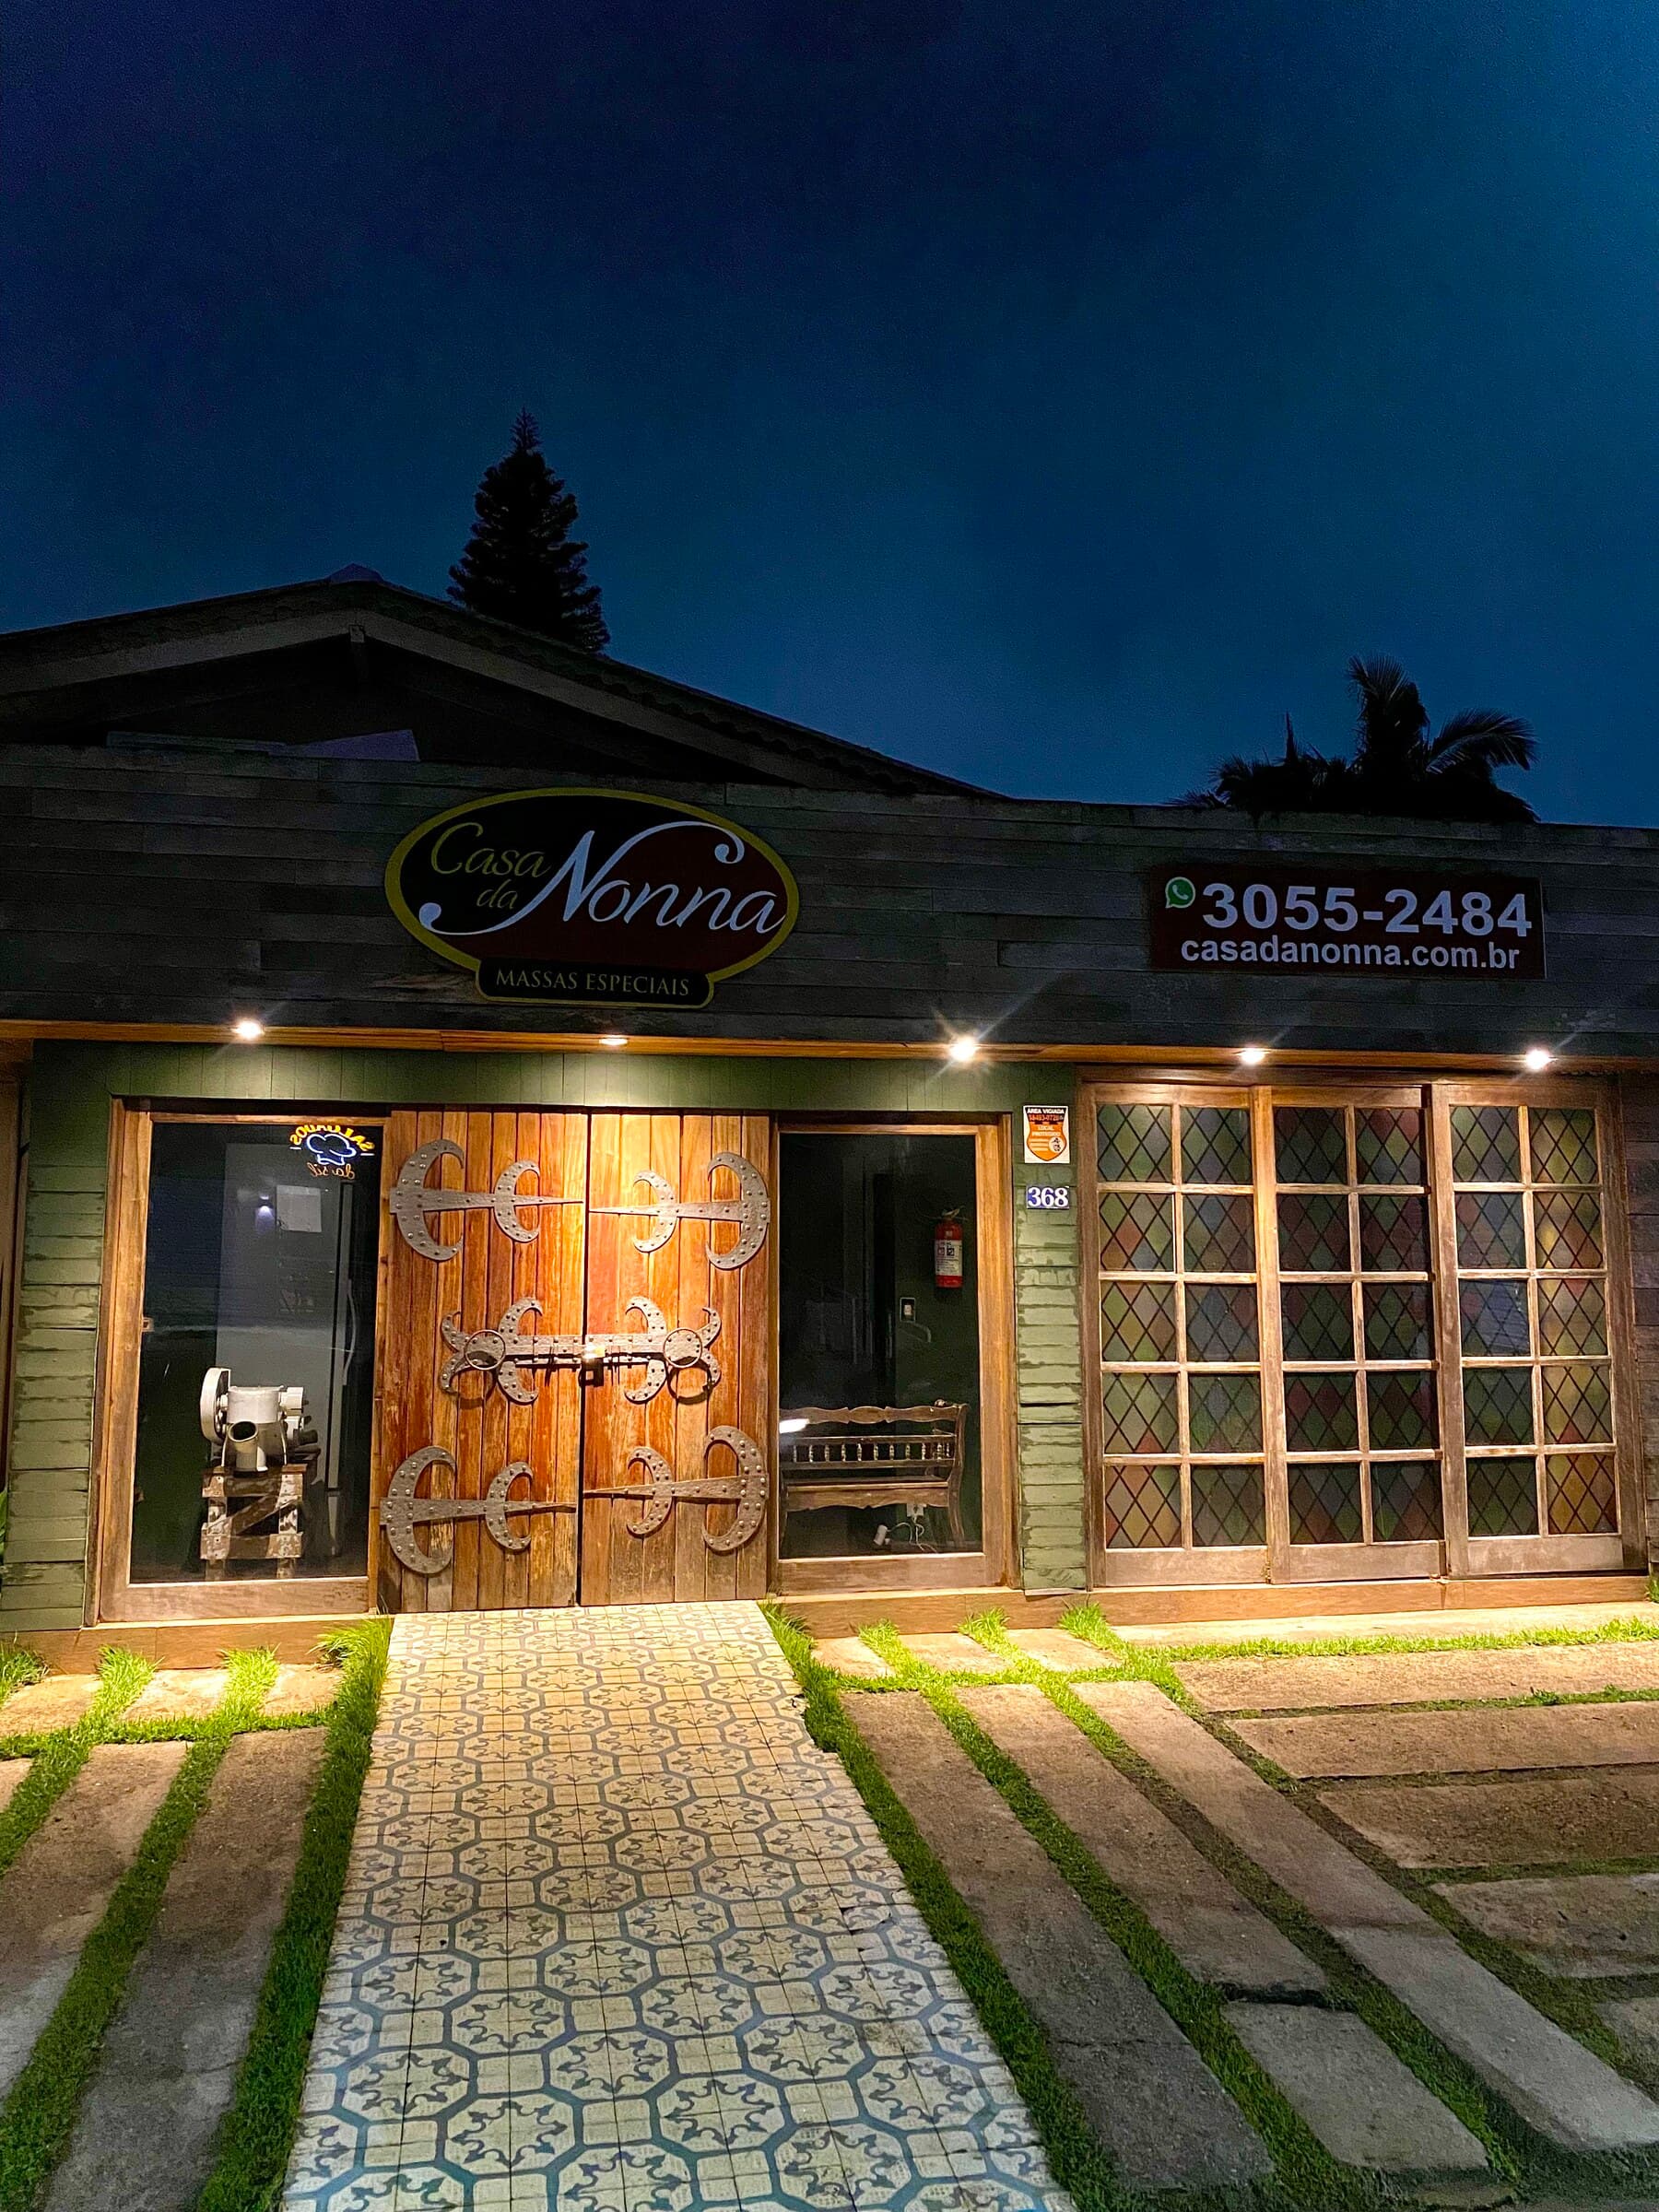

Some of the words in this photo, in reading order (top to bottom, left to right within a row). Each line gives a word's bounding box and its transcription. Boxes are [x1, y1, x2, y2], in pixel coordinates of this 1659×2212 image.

[430, 822, 552, 877] Casa
[418, 820, 787, 935] Nonna
[476, 878, 518, 911] da
[1202, 883, 1532, 936] 3055-2484
[1181, 935, 1520, 970] casadanonna.com.br
[495, 967, 578, 991] MASSAS
[585, 972, 690, 996] ESPECIAIS
[1028, 1187, 1068, 1206] 368
